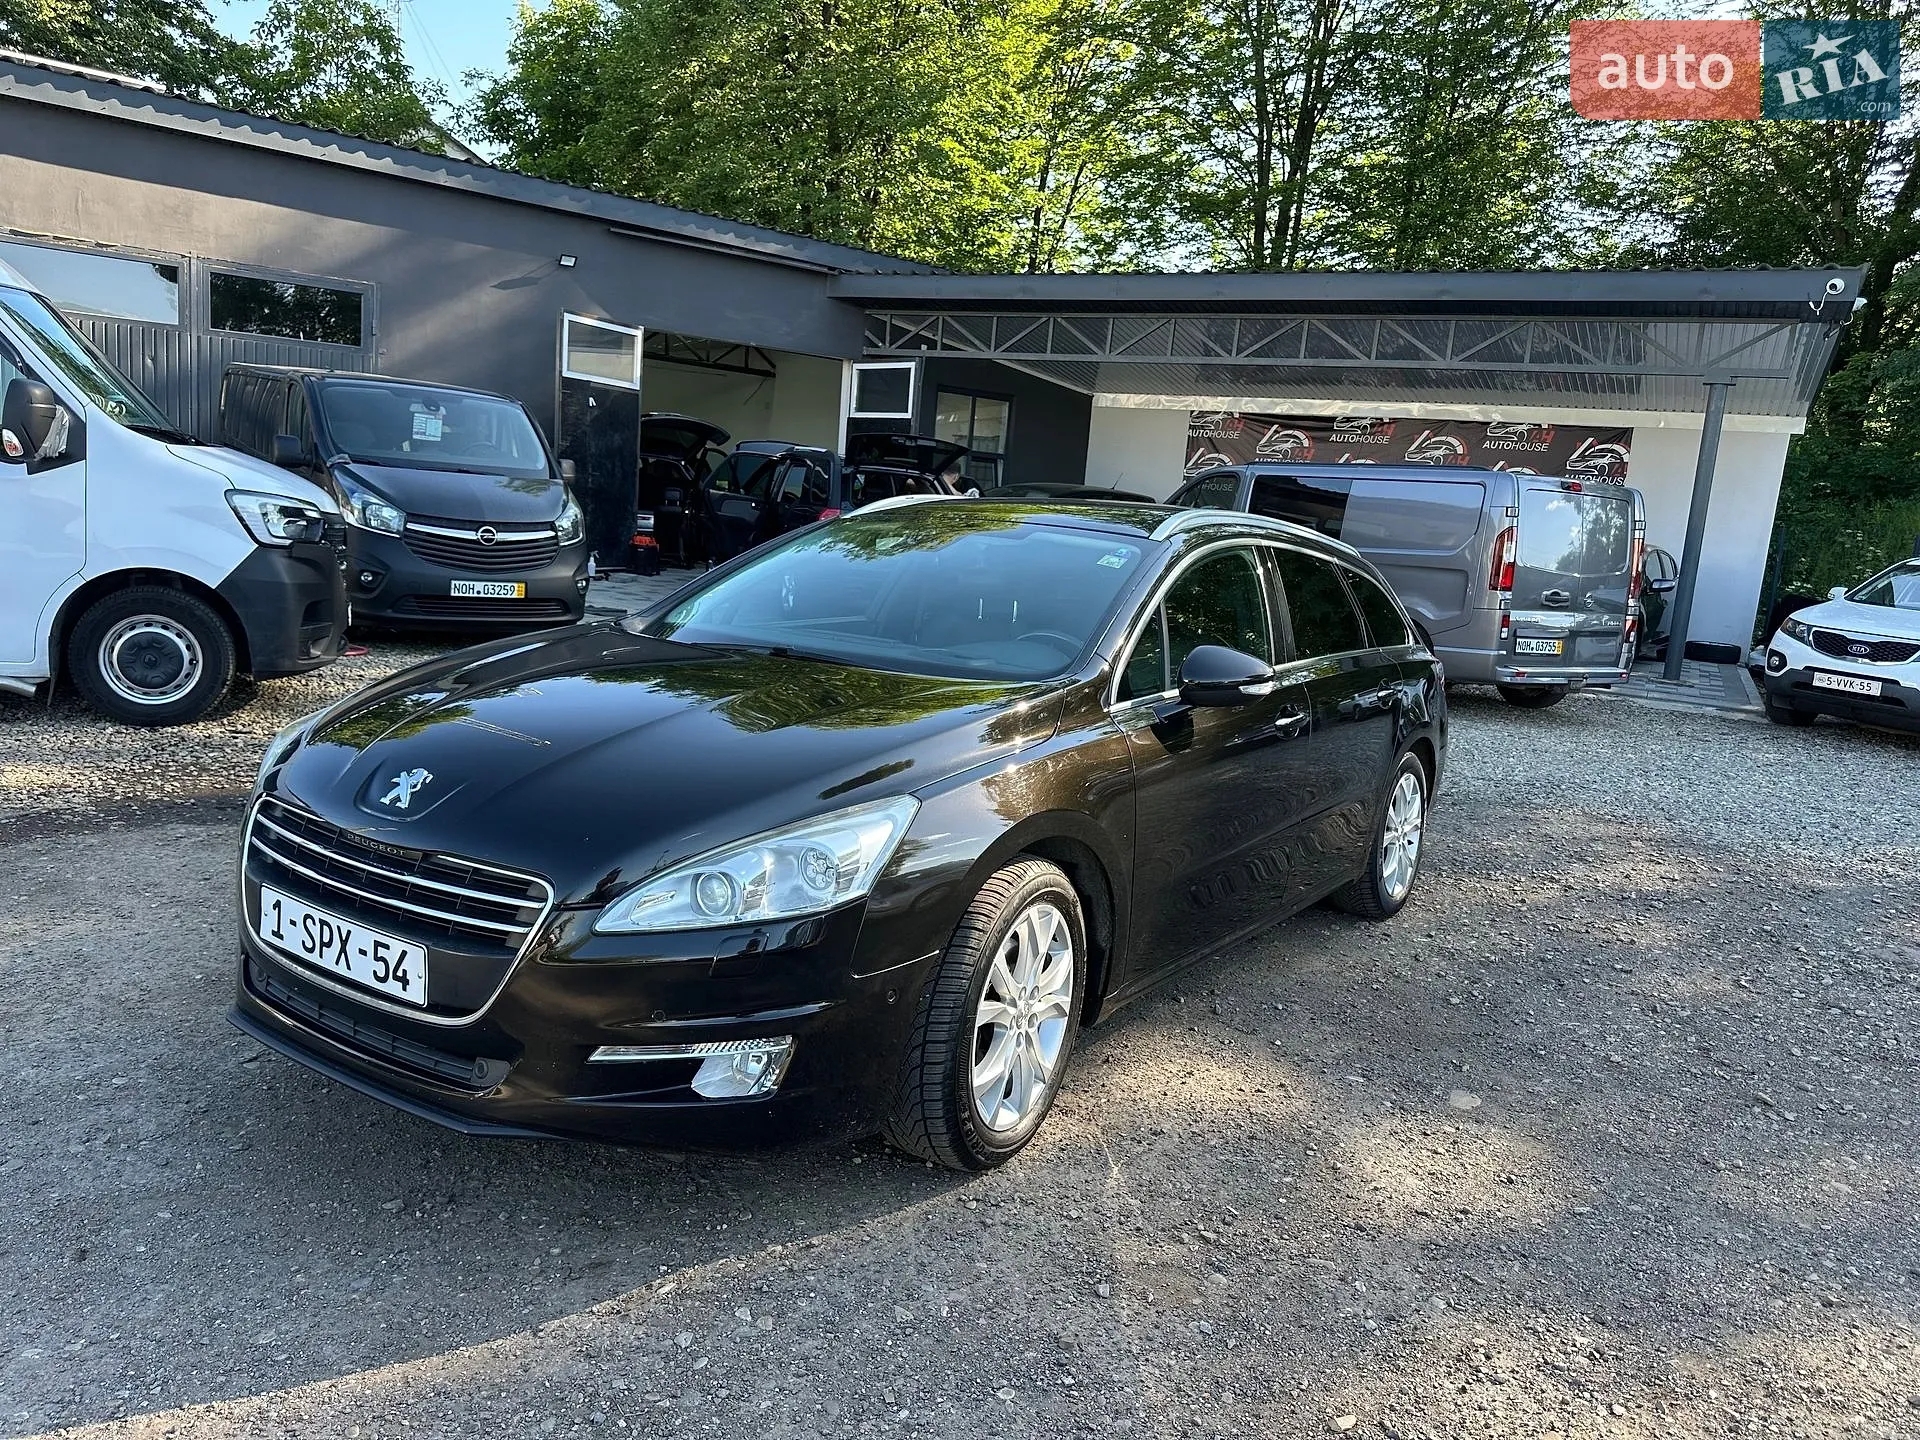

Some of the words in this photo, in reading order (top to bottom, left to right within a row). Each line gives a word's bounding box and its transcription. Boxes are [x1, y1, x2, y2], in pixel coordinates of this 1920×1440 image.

[1187, 429, 1241, 440] AUTOHOUSE
[1328, 433, 1391, 444] AUTOHOUSE
[1482, 440, 1550, 452] AUTOHOUSE
[347, 833, 406, 856] PEUGEOT
[271, 899, 410, 992] 1-SPX-54
